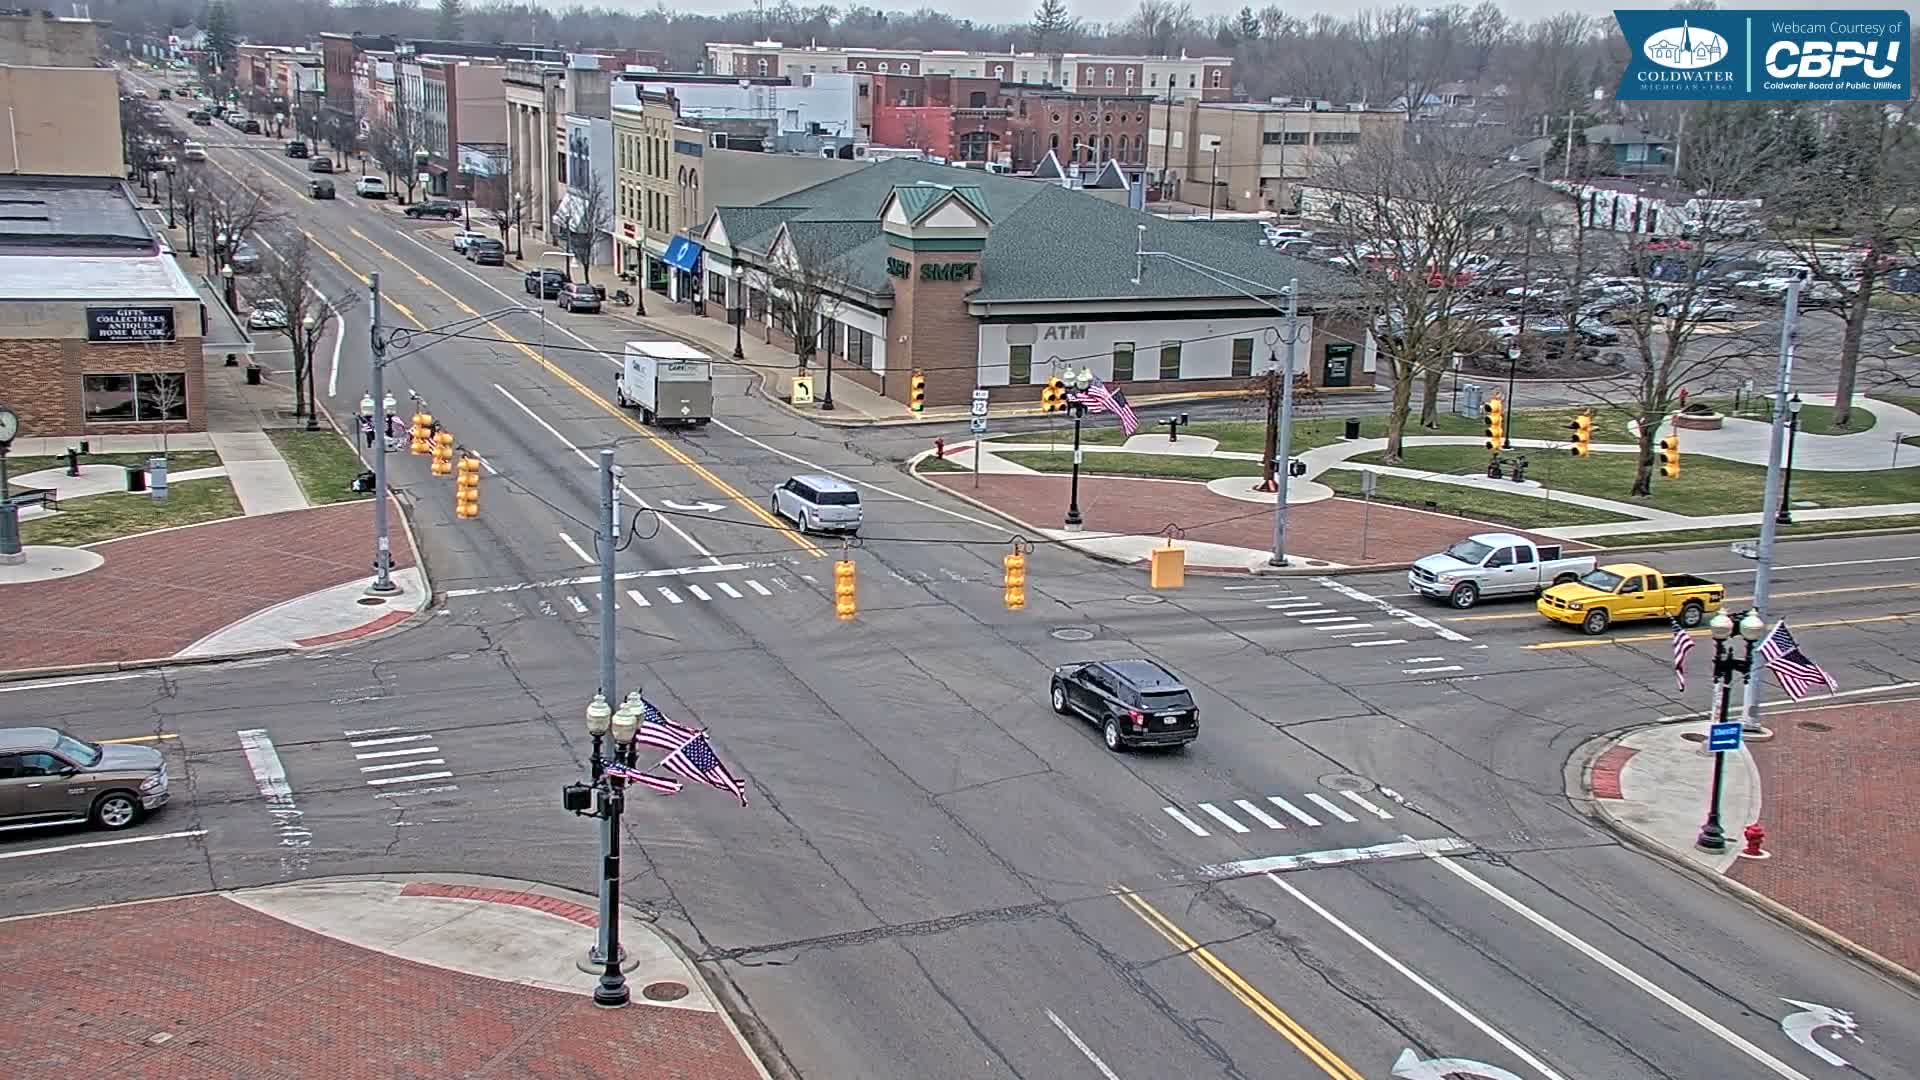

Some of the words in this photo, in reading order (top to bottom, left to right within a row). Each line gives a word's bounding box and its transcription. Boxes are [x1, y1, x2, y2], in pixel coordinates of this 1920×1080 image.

[117, 309, 145, 317] GIFTS
[96, 315, 165, 323] COLLECTIBLES
[109, 322, 155, 330] ANTIQUES
[99, 329, 128, 337] HOME
[1043, 324, 1086, 340] ATM
[975, 402, 985, 412] 12
